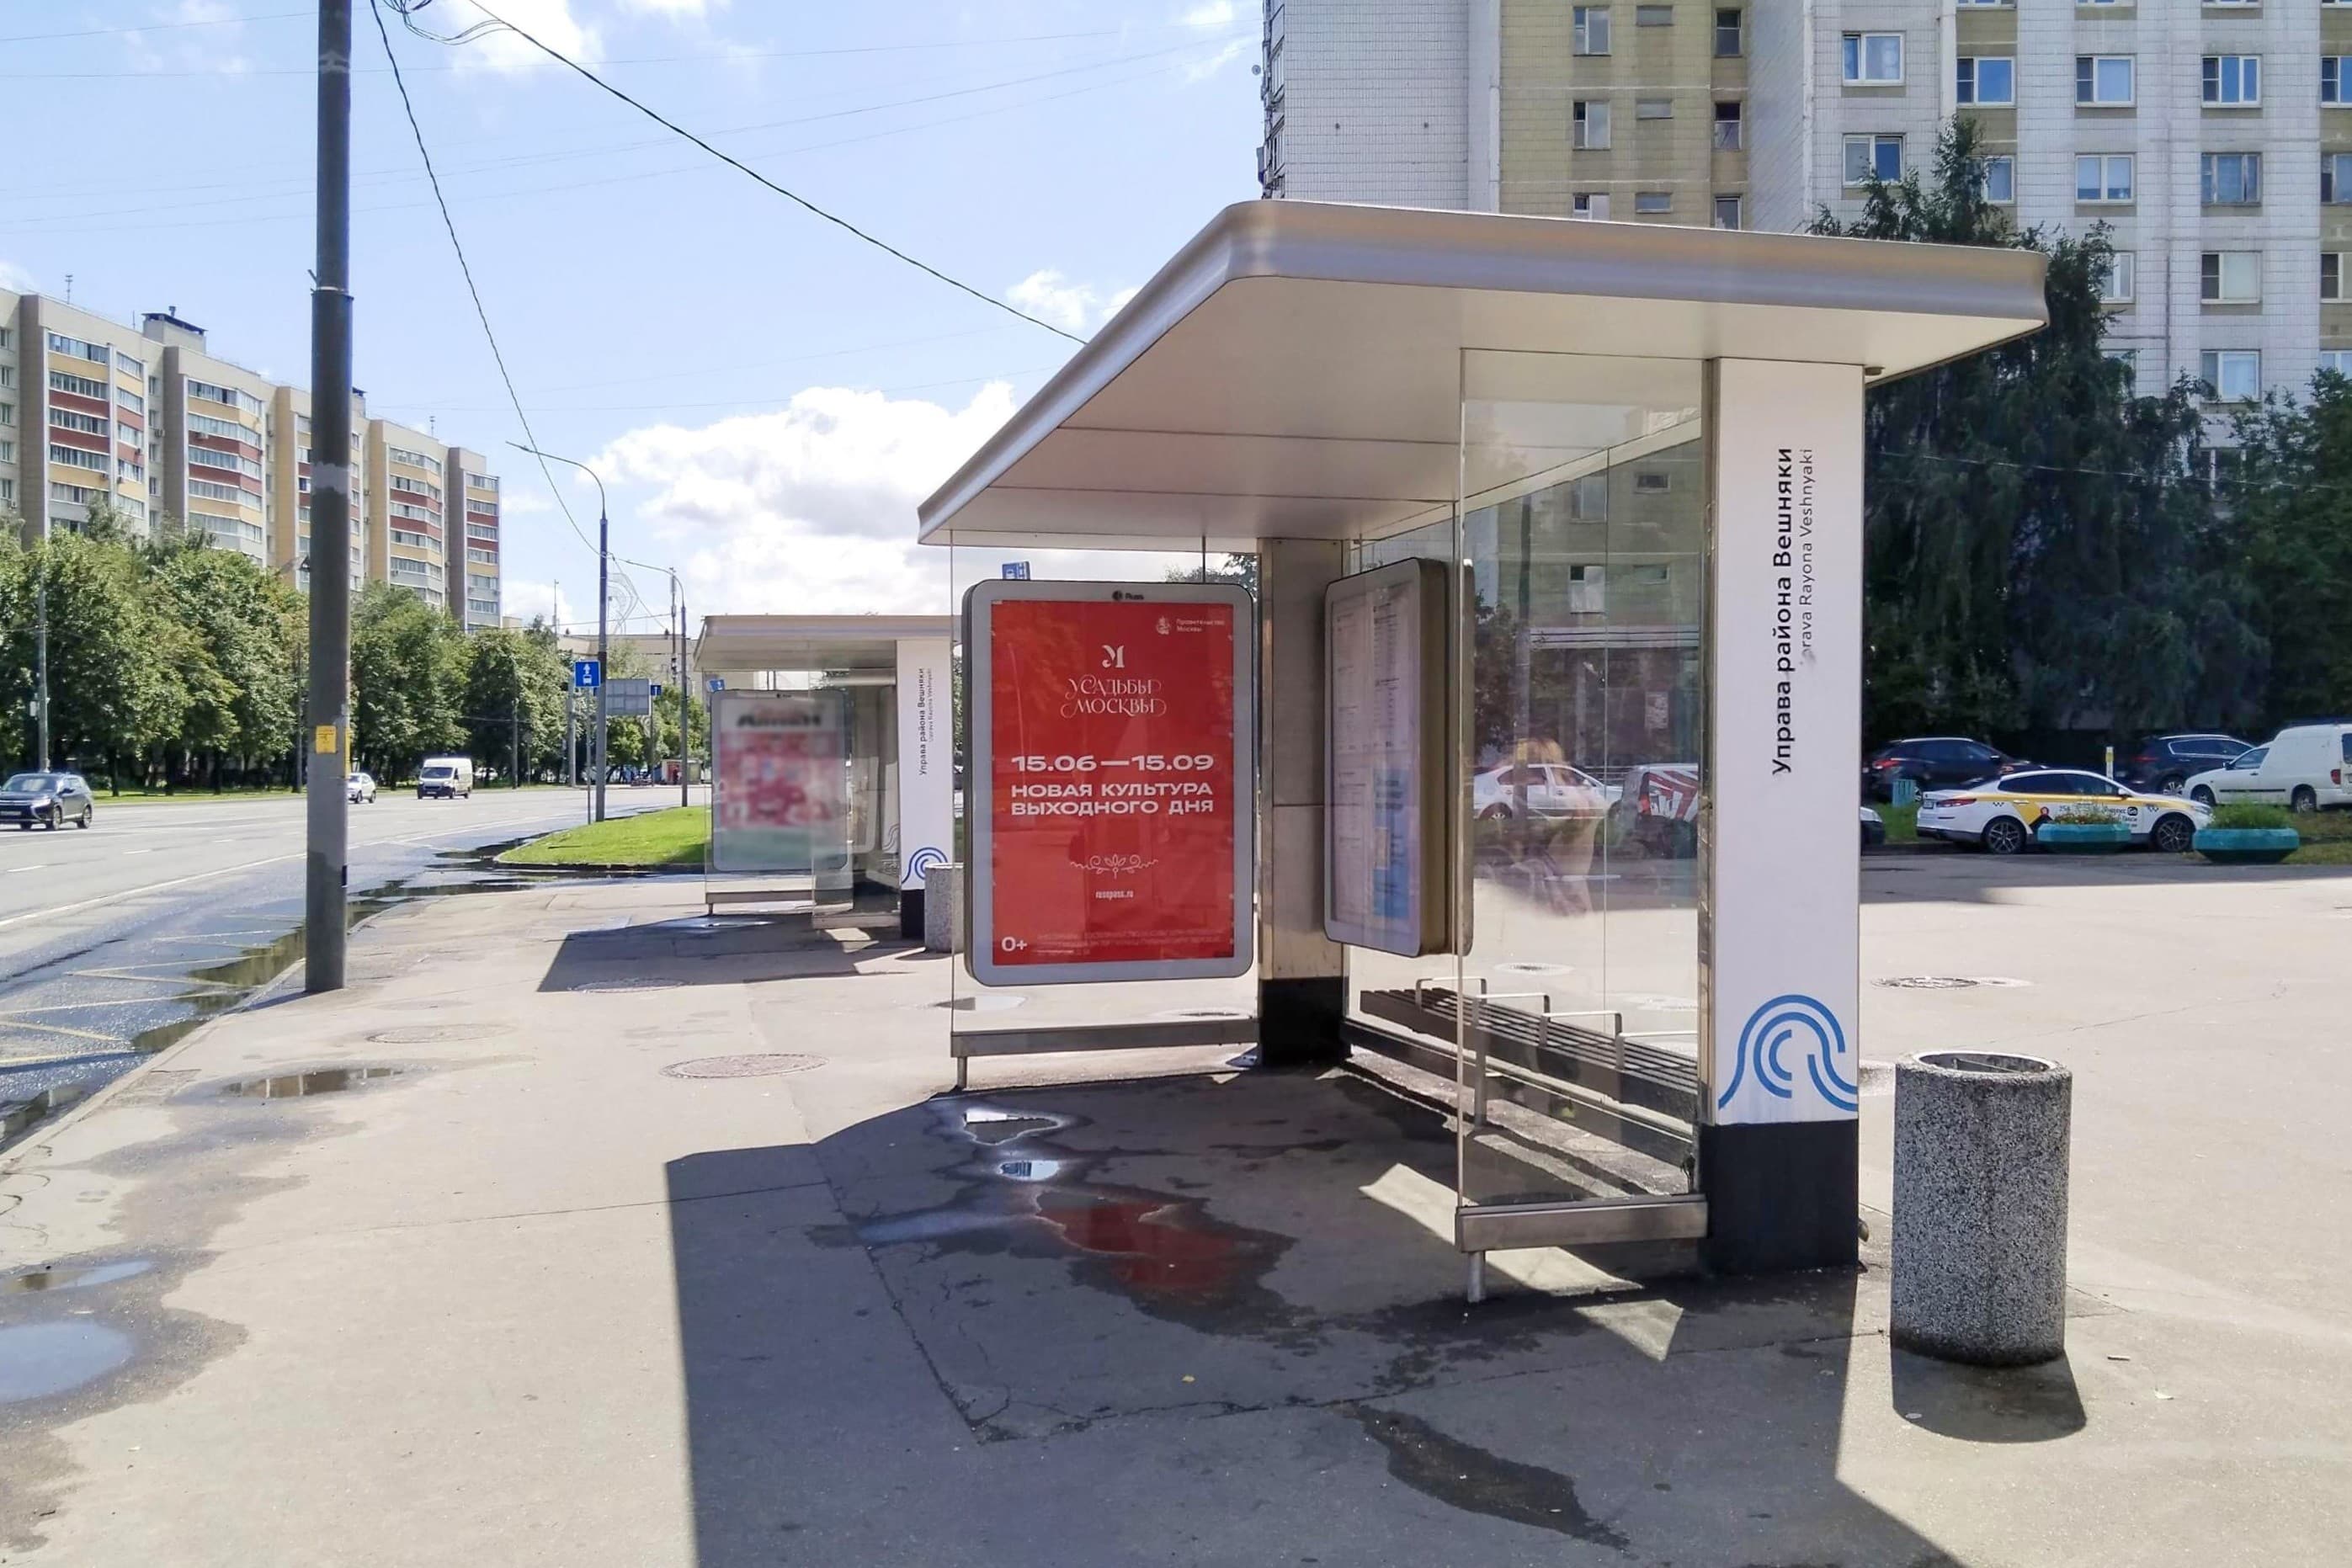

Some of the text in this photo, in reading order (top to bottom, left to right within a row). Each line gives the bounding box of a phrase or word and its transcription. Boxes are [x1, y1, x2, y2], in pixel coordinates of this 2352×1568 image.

[1799, 448, 1816, 538] Veshnyaki
[1799, 543, 1816, 606] Rayona
[1772, 448, 1796, 775] Управа района Вешняки
[1065, 674, 1162, 699] УСАДЬБЫ
[1060, 698, 1167, 718] МОСКВЫ
[918, 710, 928, 741] района
[918, 744, 928, 775] Управа
[1011, 783, 1213, 798] НОВАЯ КУЛЬТУРА
[1011, 800, 1213, 816] ВЫХОДНОГО ДНЯ
[1002, 936, 1027, 952] 0+
